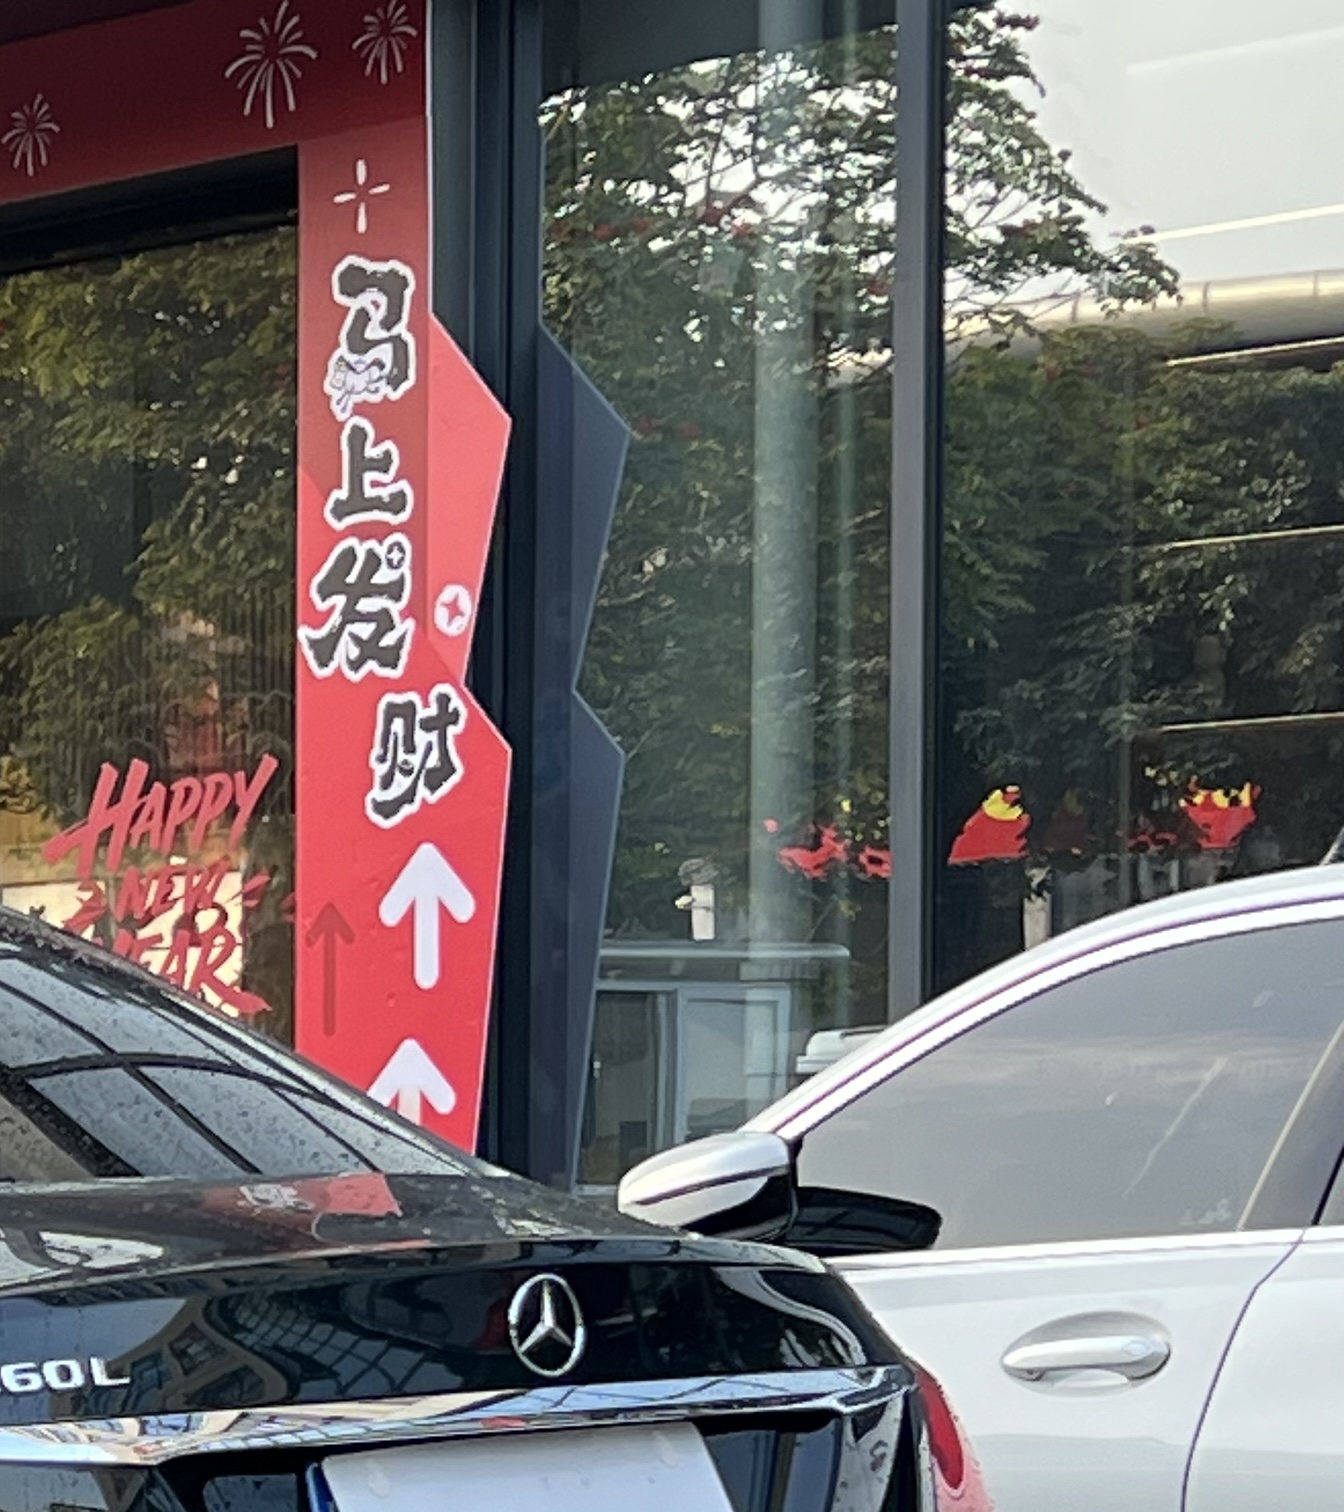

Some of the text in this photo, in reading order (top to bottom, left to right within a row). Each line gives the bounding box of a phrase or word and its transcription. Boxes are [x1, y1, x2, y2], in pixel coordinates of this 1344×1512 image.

[298, 253, 466, 828] 马上发财
[42, 753, 279, 880] HAPPY
[115, 855, 231, 922] NEW
